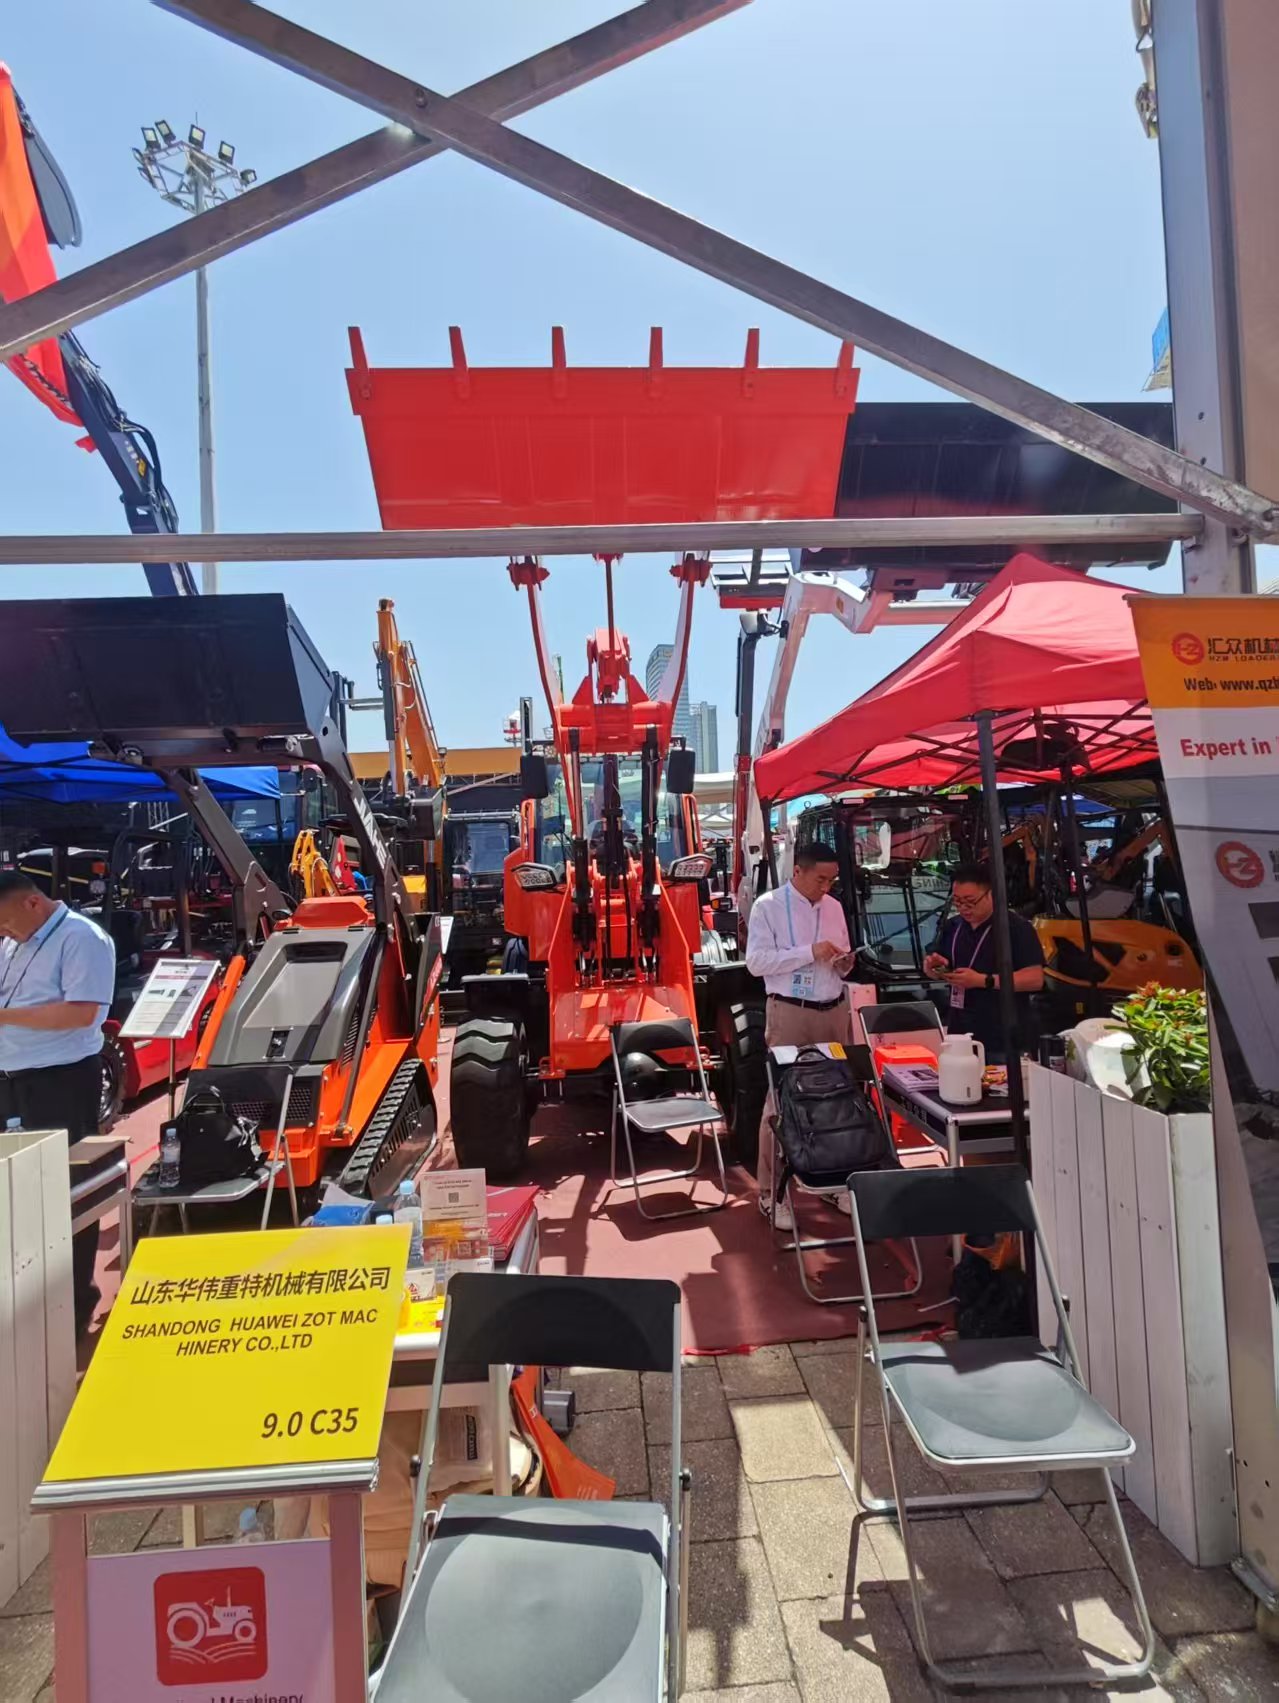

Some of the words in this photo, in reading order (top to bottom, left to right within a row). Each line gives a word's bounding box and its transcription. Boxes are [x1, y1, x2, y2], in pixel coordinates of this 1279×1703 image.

[1180, 738, 1247, 760] Expert
[1251, 737, 1271, 755] in
[130, 1266, 391, 1306] 山东华伟重特机械有限公司
[122, 1318, 222, 1340] SHANDONG
[229, 1313, 299, 1333] HUAWEI
[300, 1311, 337, 1328] ZOT
[339, 1308, 378, 1326] MAC
[176, 1337, 243, 1357] HINERY
[245, 1333, 313, 1353] CO.,LTD
[261, 1412, 303, 1439] 9.0
[309, 1407, 359, 1436] C35
